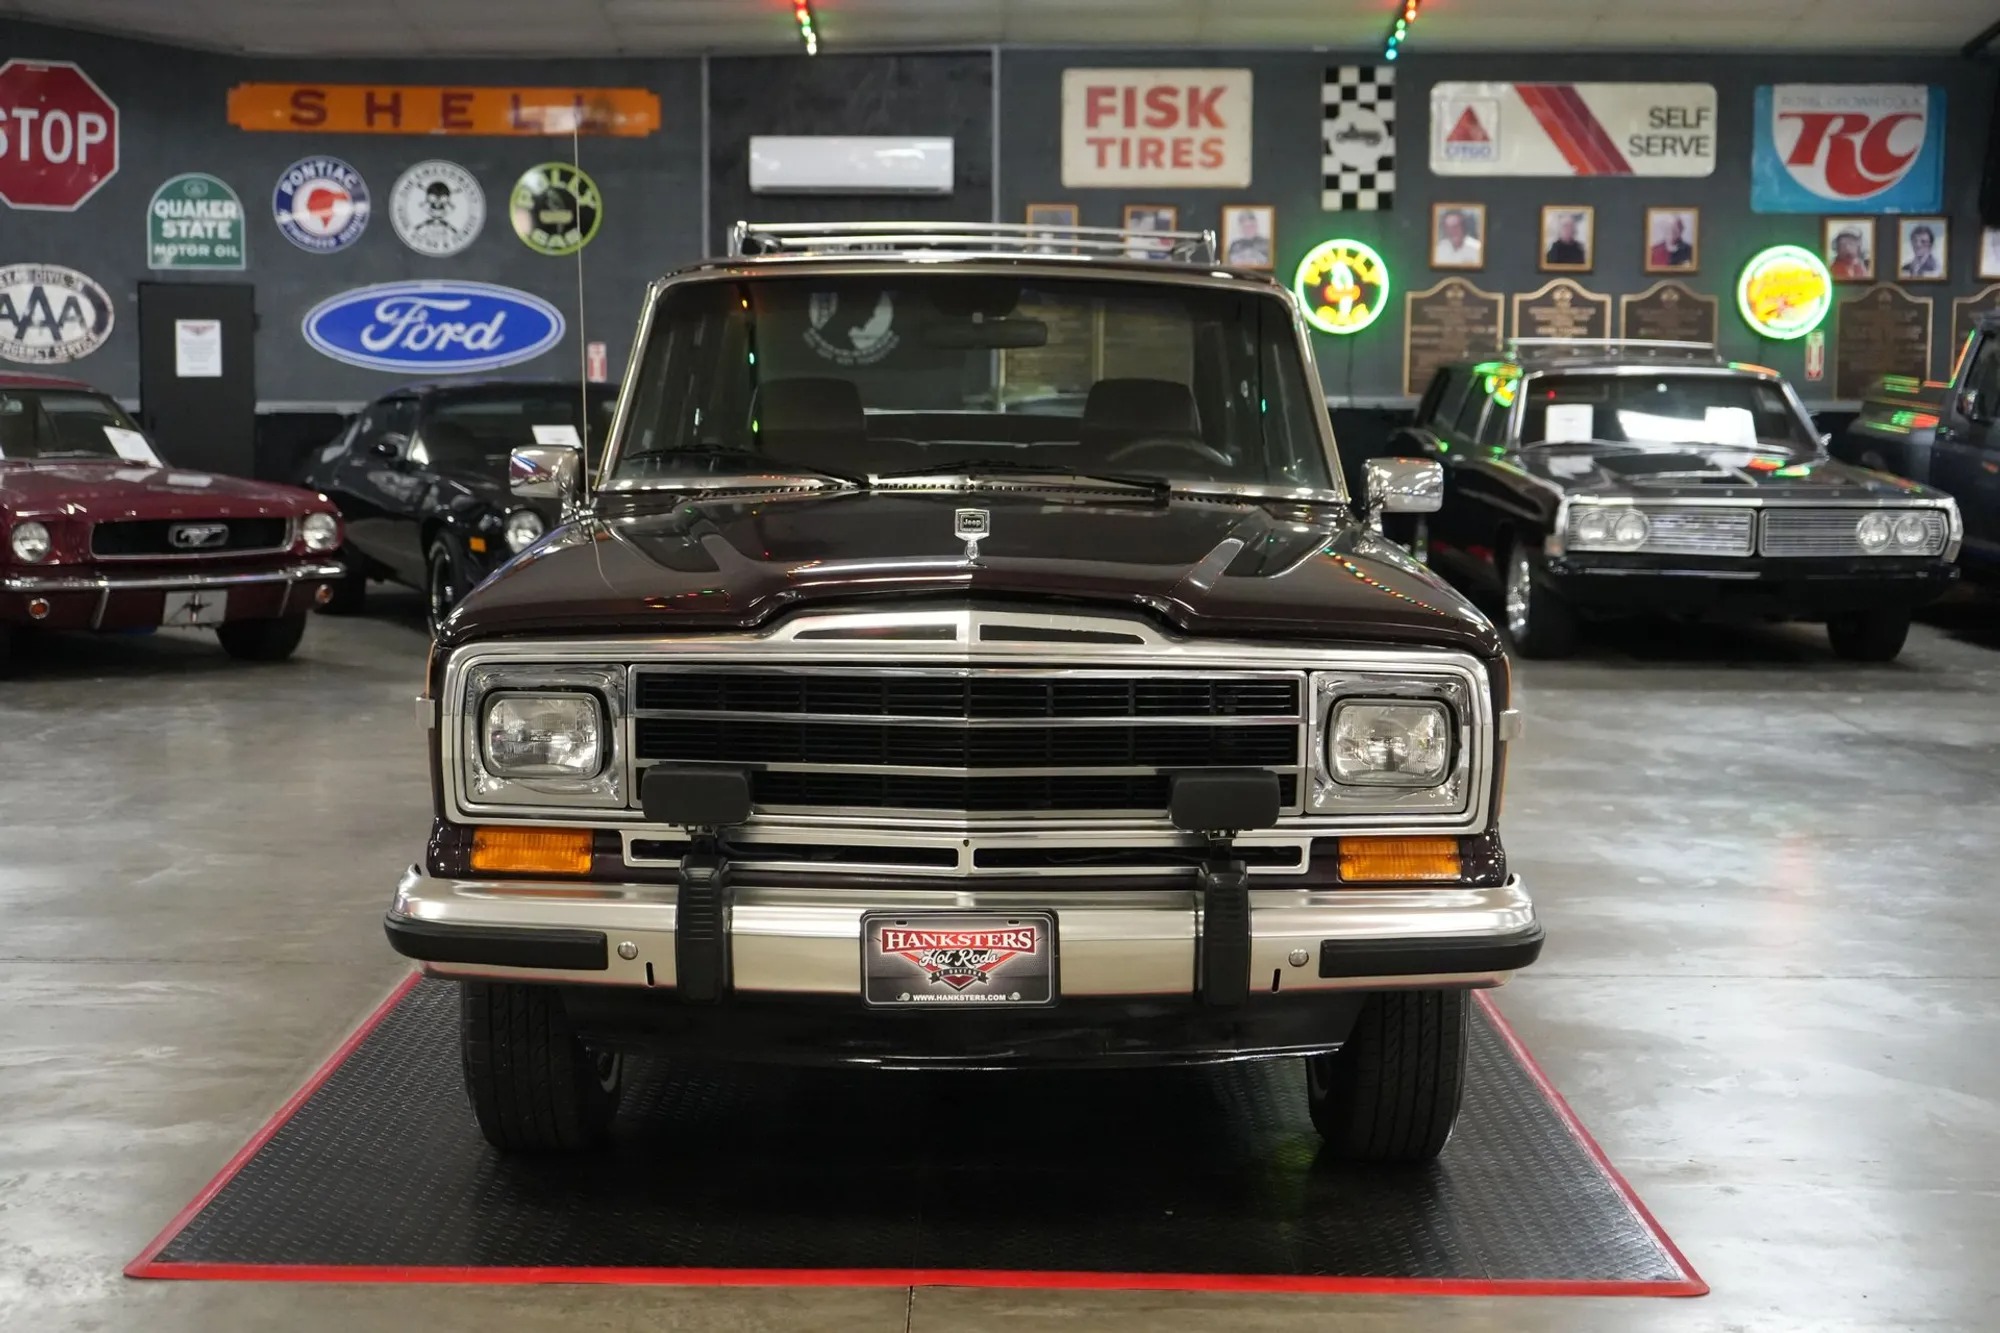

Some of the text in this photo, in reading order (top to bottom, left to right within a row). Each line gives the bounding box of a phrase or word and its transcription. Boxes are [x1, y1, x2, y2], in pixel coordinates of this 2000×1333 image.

[1085, 86, 1228, 130] FISK
[1649, 106, 1710, 130] SELF
[1085, 137, 1226, 169] TIRES
[1628, 134, 1711, 158] SERVE
[1779, 113, 1924, 198] RC
[281, 160, 359, 196] PONTIAC
[154, 200, 239, 220] QUAKER
[162, 220, 232, 240] STATE
[154, 243, 240, 258] MOTOR OIL
[360, 296, 507, 353] Ford
[963, 518, 982, 528] Jeep
[886, 930, 1033, 950] HANKSTERS
[919, 948, 999, 968] Hot Rods
